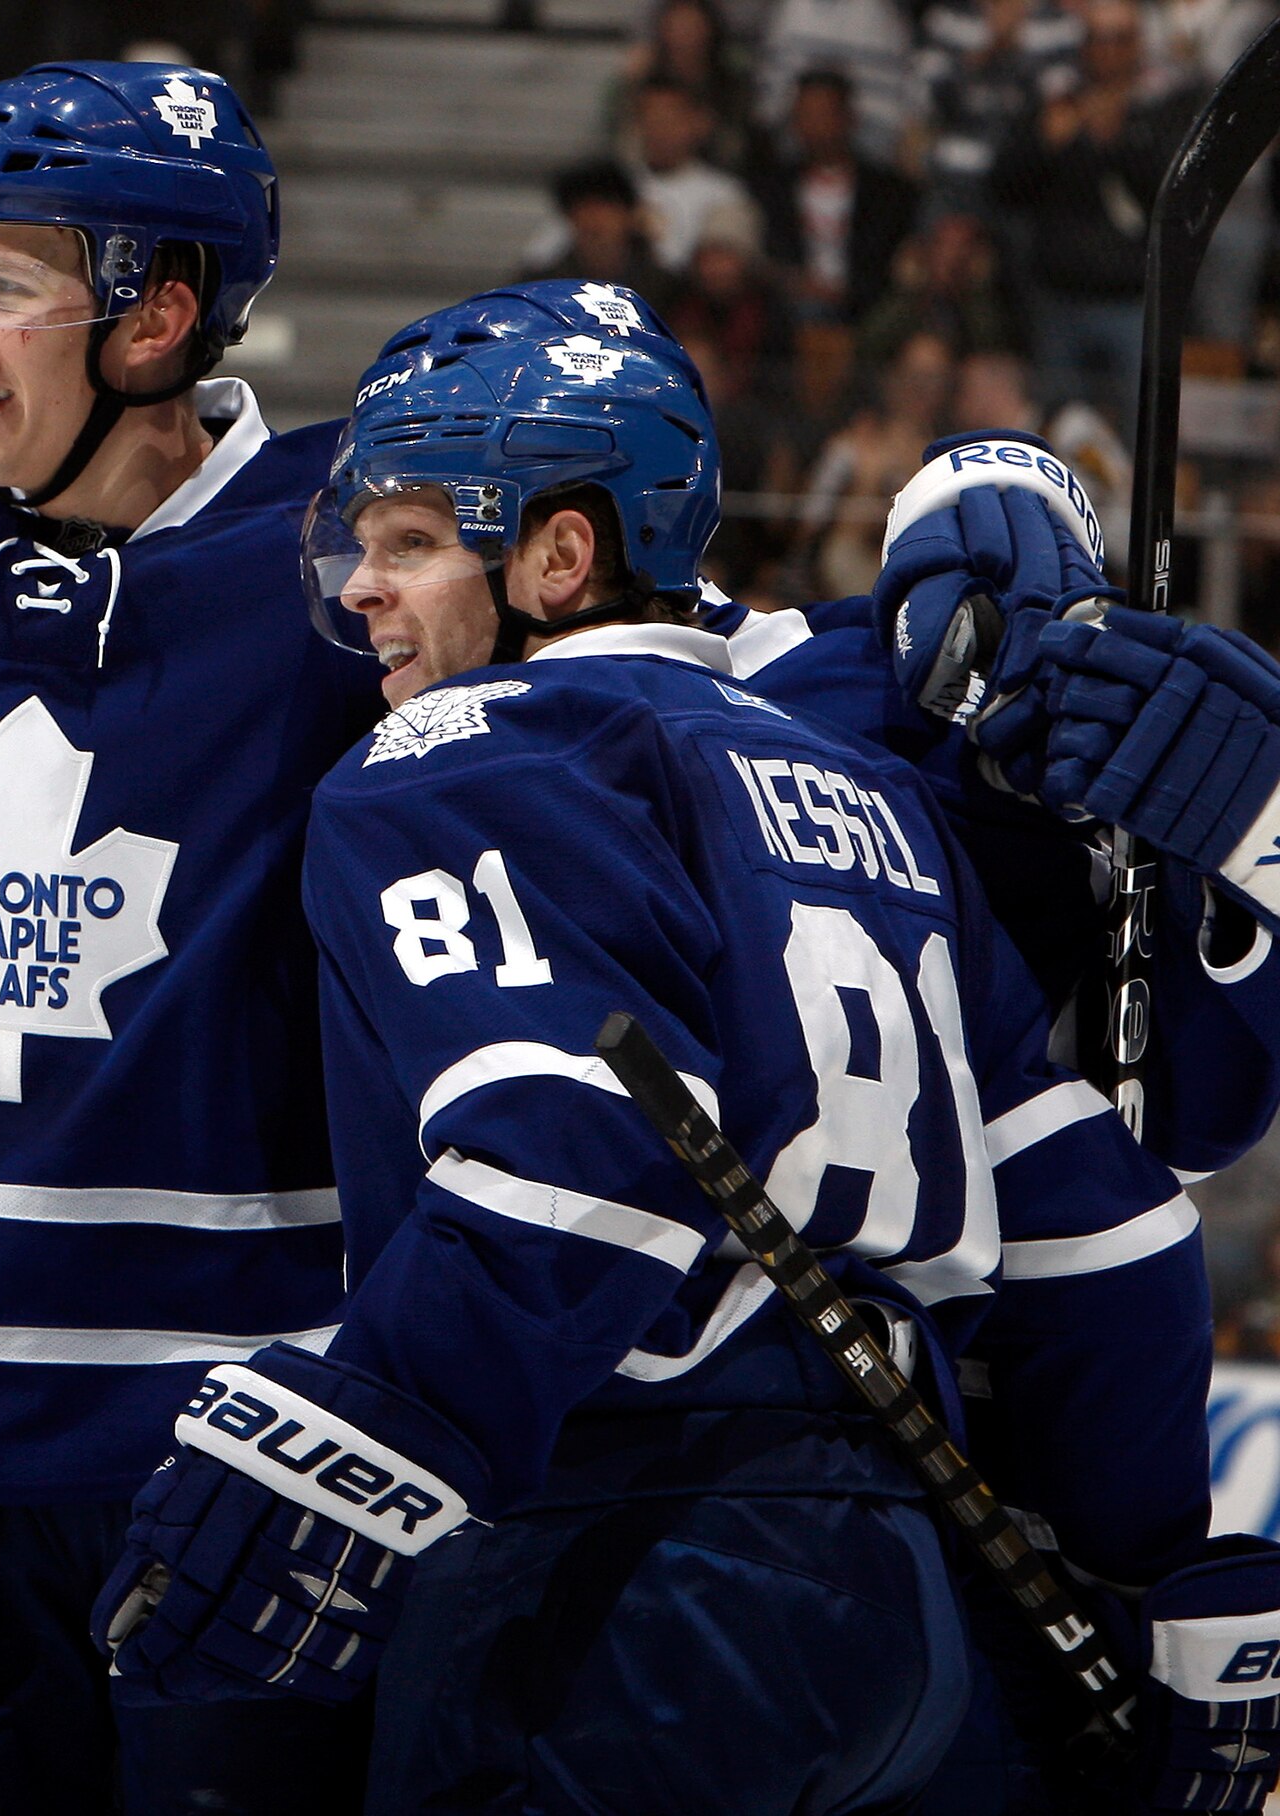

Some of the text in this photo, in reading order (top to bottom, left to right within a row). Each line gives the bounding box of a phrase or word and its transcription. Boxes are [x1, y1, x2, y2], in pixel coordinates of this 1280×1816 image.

[355, 367, 415, 408] CCM
[461, 522, 506, 533] BAUER
[727, 749, 941, 897] KESSEL
[379, 849, 554, 987] 81
[720, 900, 1002, 1307] 81
[179, 1378, 444, 1535] BAUER
